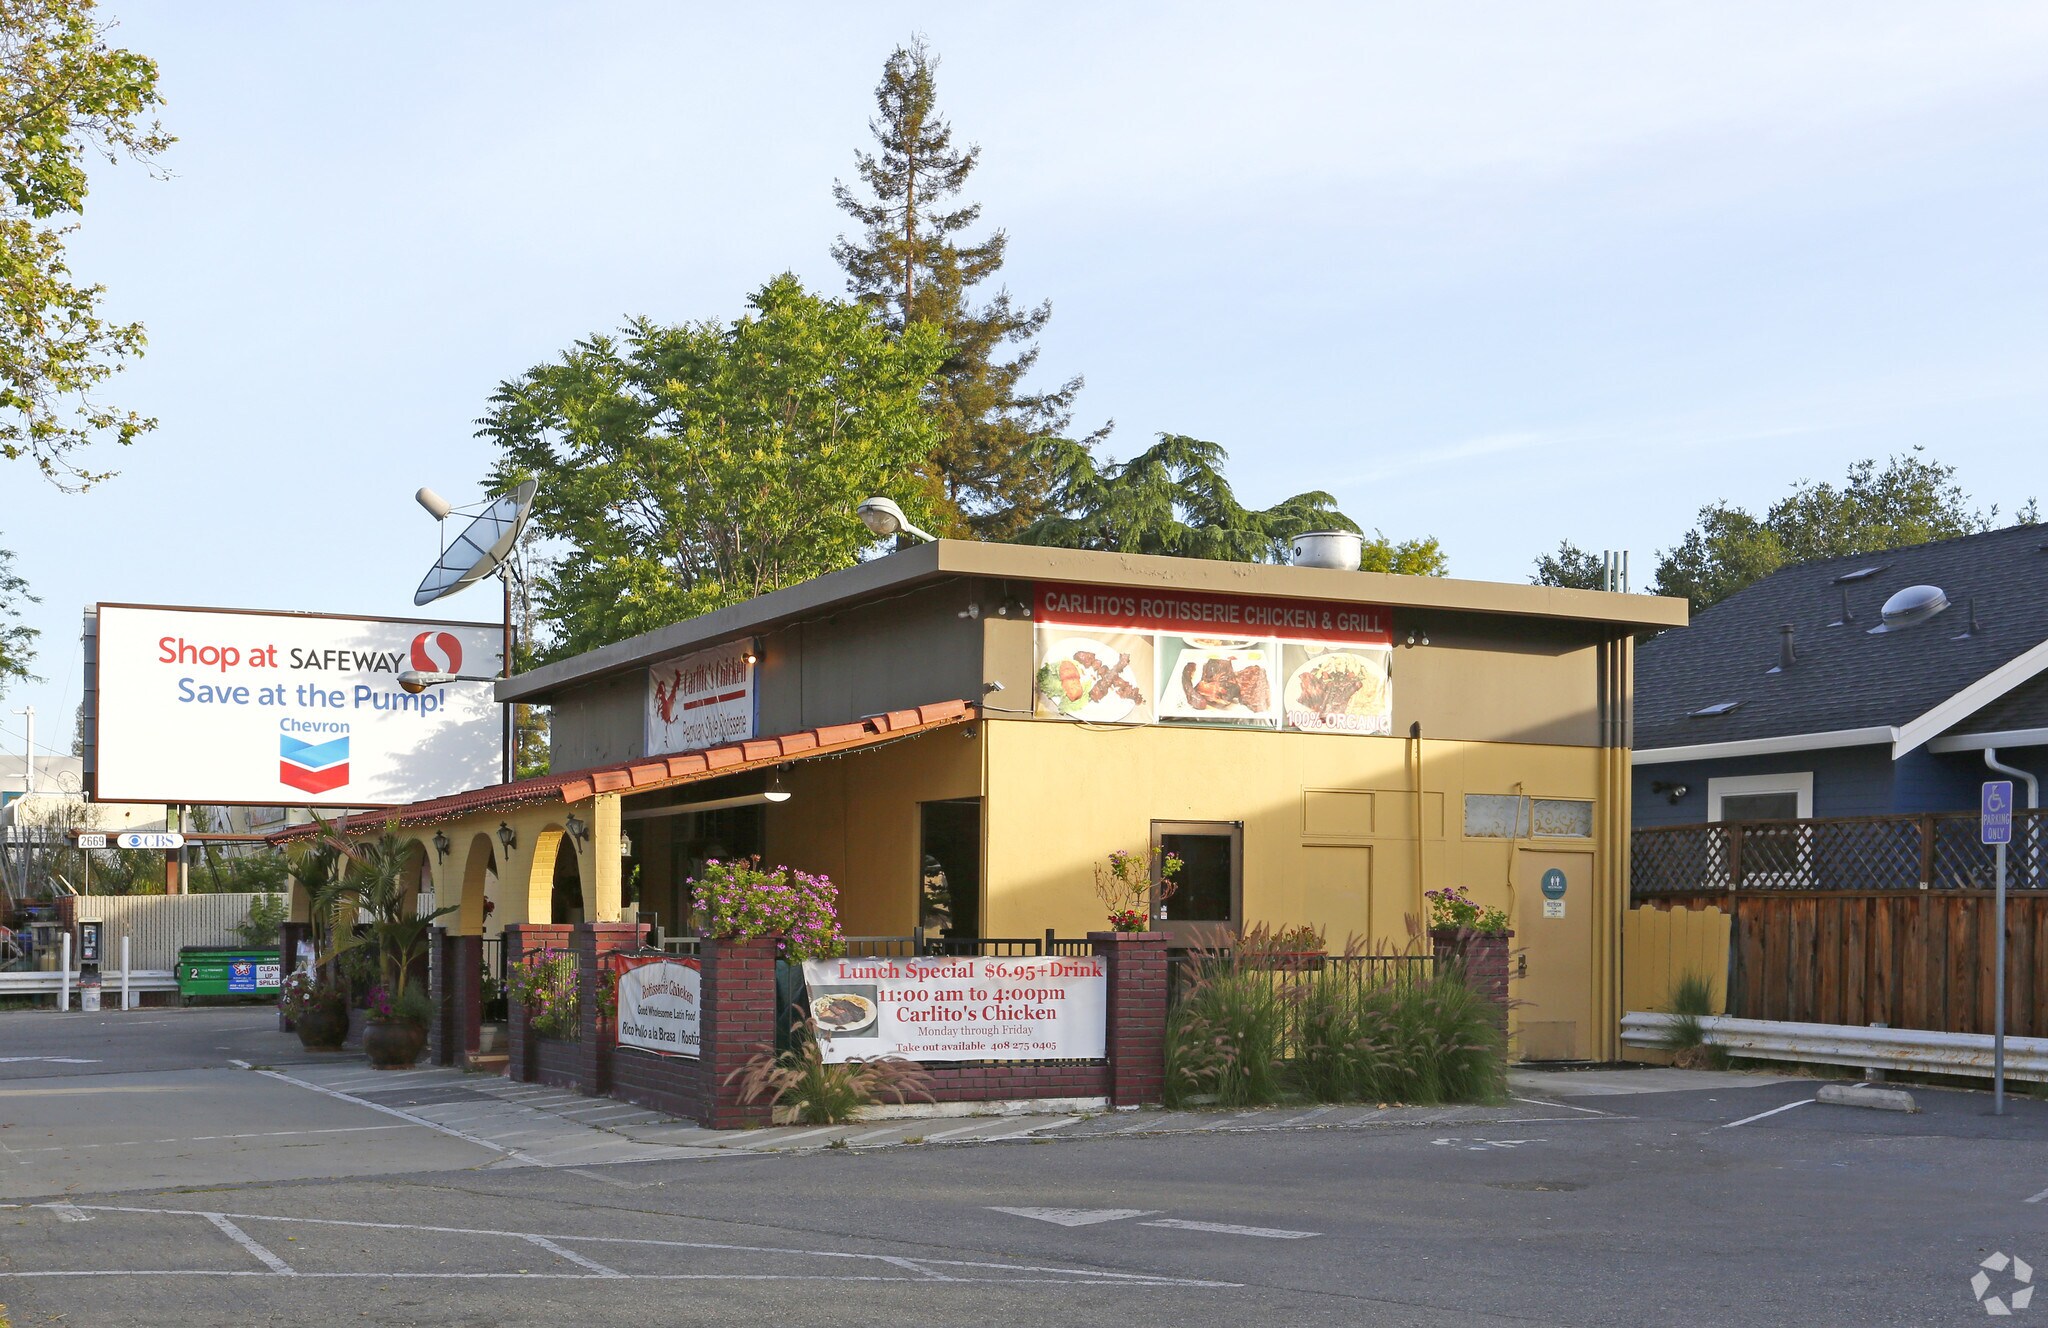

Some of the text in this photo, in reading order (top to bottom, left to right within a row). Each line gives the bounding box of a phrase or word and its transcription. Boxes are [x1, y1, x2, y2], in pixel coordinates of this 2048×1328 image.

[1045, 592, 1383, 633] CARLITO'S ROTISSERIE CHICKEN & GRILL
[158, 636, 406, 673] Shop at SAFEWAY
[178, 677, 445, 717] Save at the Pump!
[279, 717, 350, 733] Chevron
[1286, 710, 1322, 728] 100%
[1983, 813, 2010, 825] PARKING
[81, 836, 105, 846] 2669
[144, 834, 174, 847] CBS
[1988, 827, 2005, 840] ONLY
[191, 968, 198, 979] 2
[838, 961, 1103, 983] Lunch Special $6.95+Drink
[642, 980, 694, 1005] Rotisserie Chicken
[879, 987, 1066, 1004] 11:00 am to 4:00pm
[638, 1004, 696, 1021] Good Wholesome Latin Food
[896, 1003, 1057, 1023] Carlito's Chicken
[622, 1021, 634, 1035] Rico
[648, 1031, 652, 1039] a
[652, 1026, 658, 1040] la
[660, 1027, 676, 1042] Brasa
[918, 1024, 1034, 1038] Monday through Friday
[896, 1041, 1057, 1052] Take out available 408 275 0405
